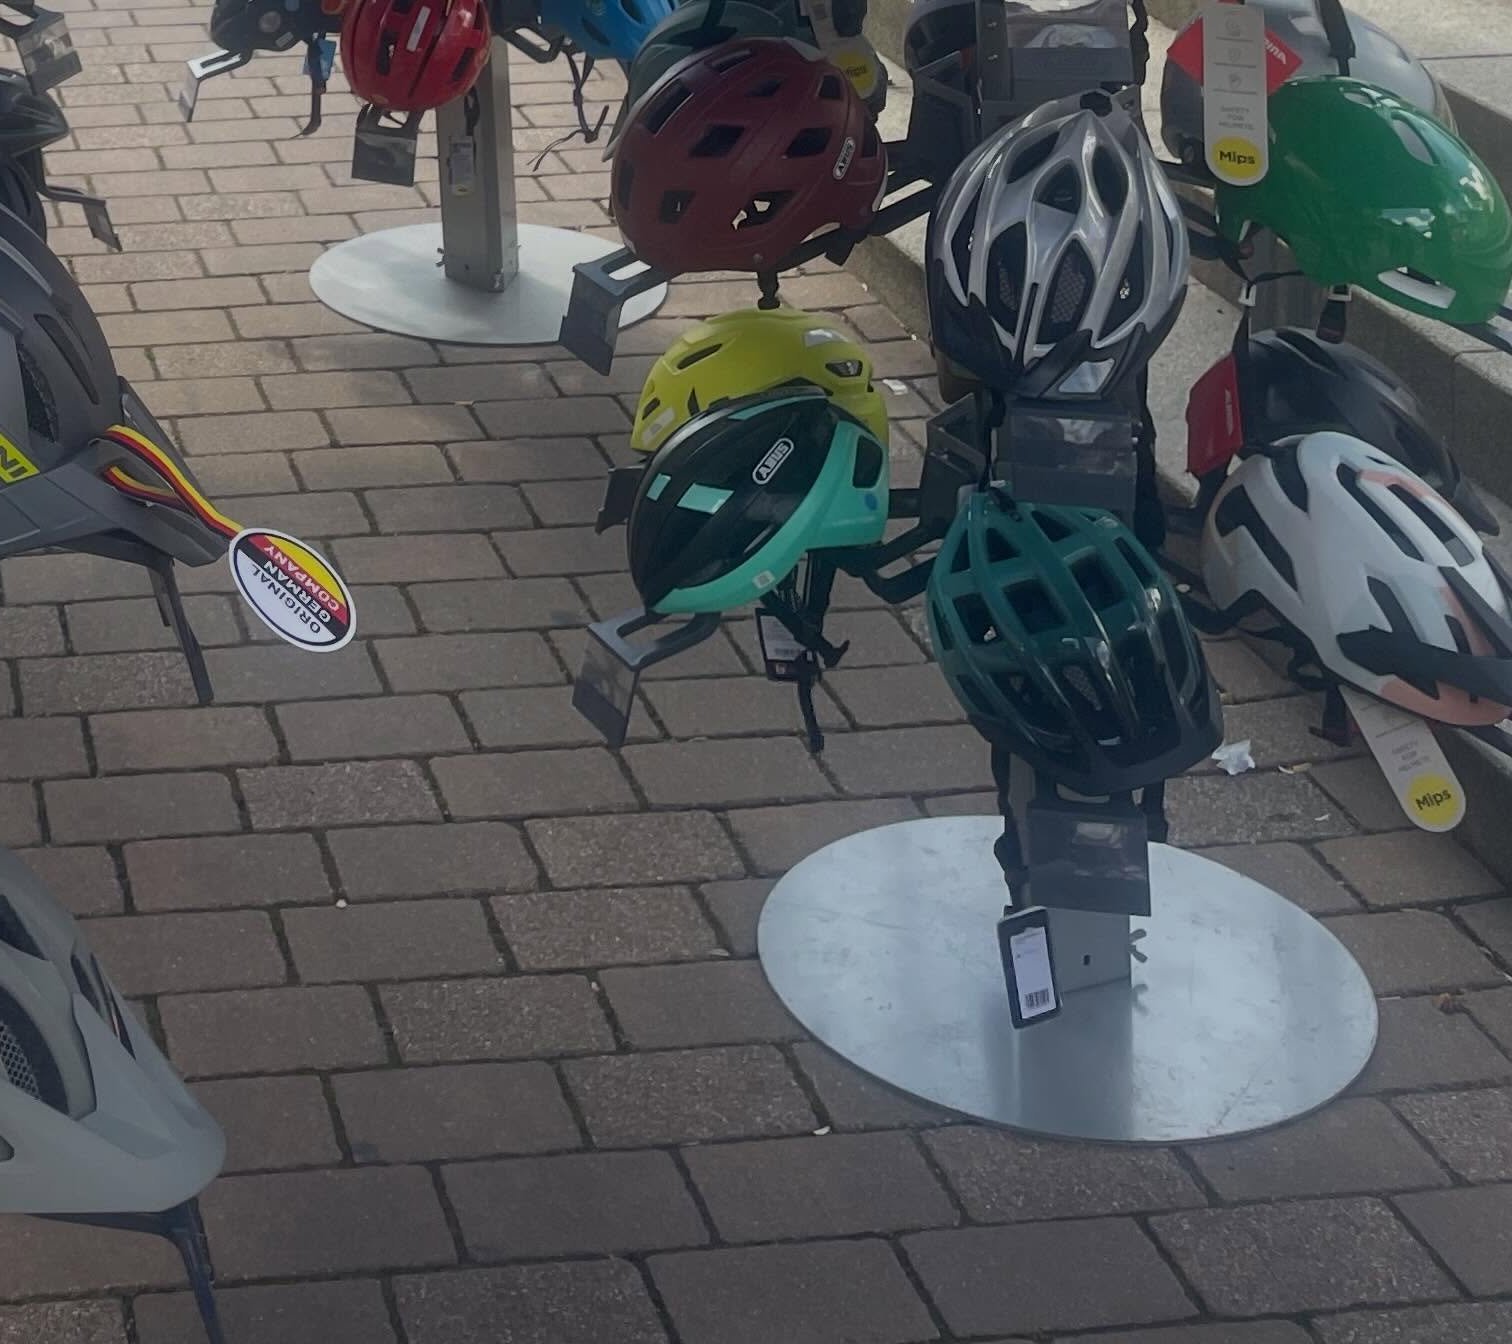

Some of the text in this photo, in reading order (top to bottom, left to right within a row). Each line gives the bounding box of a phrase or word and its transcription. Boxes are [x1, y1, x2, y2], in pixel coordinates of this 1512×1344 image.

[837, 140, 854, 176] ABUS
[1219, 150, 1256, 165] Mips
[758, 442, 789, 479] ABUS
[263, 545, 340, 611] COMPANY
[263, 560, 331, 623] GERMAN
[251, 564, 321, 634] ORIGINAL
[1415, 789, 1452, 810] Mips
